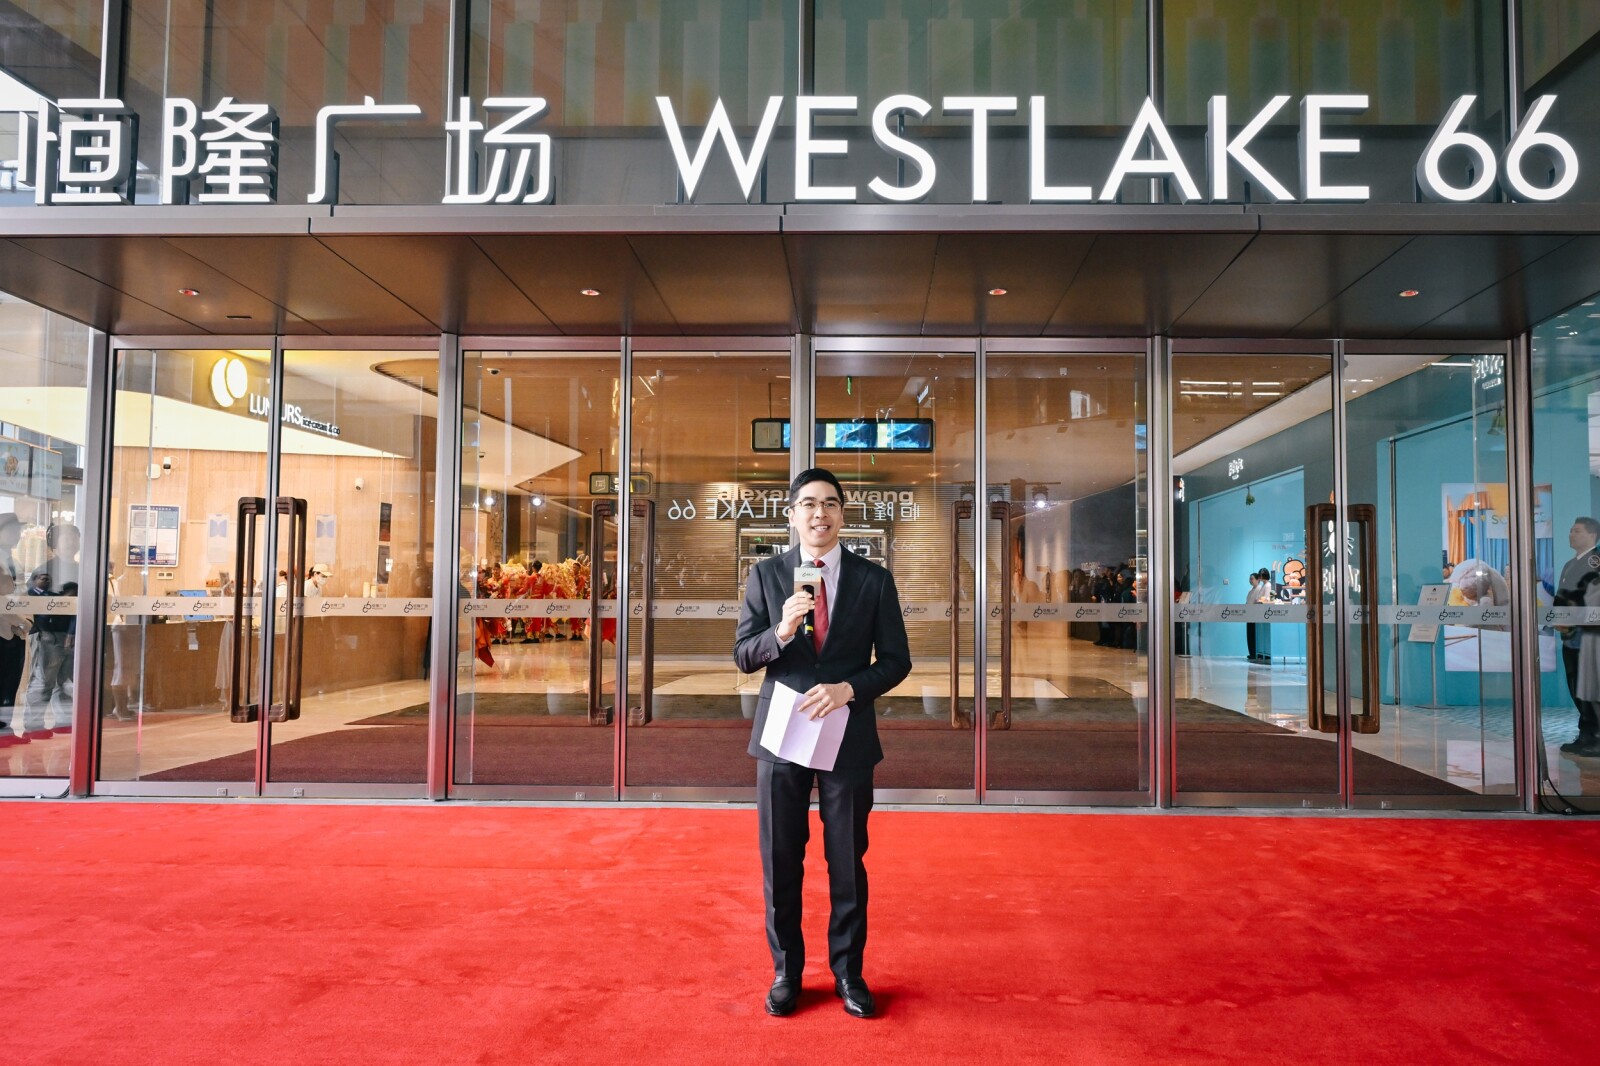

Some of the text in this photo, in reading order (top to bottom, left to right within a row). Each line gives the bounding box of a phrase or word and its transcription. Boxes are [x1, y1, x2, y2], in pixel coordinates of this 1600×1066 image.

[18, 97, 551, 204] 恒隆广场
[655, 94, 1580, 202] WESTLAKE 66
